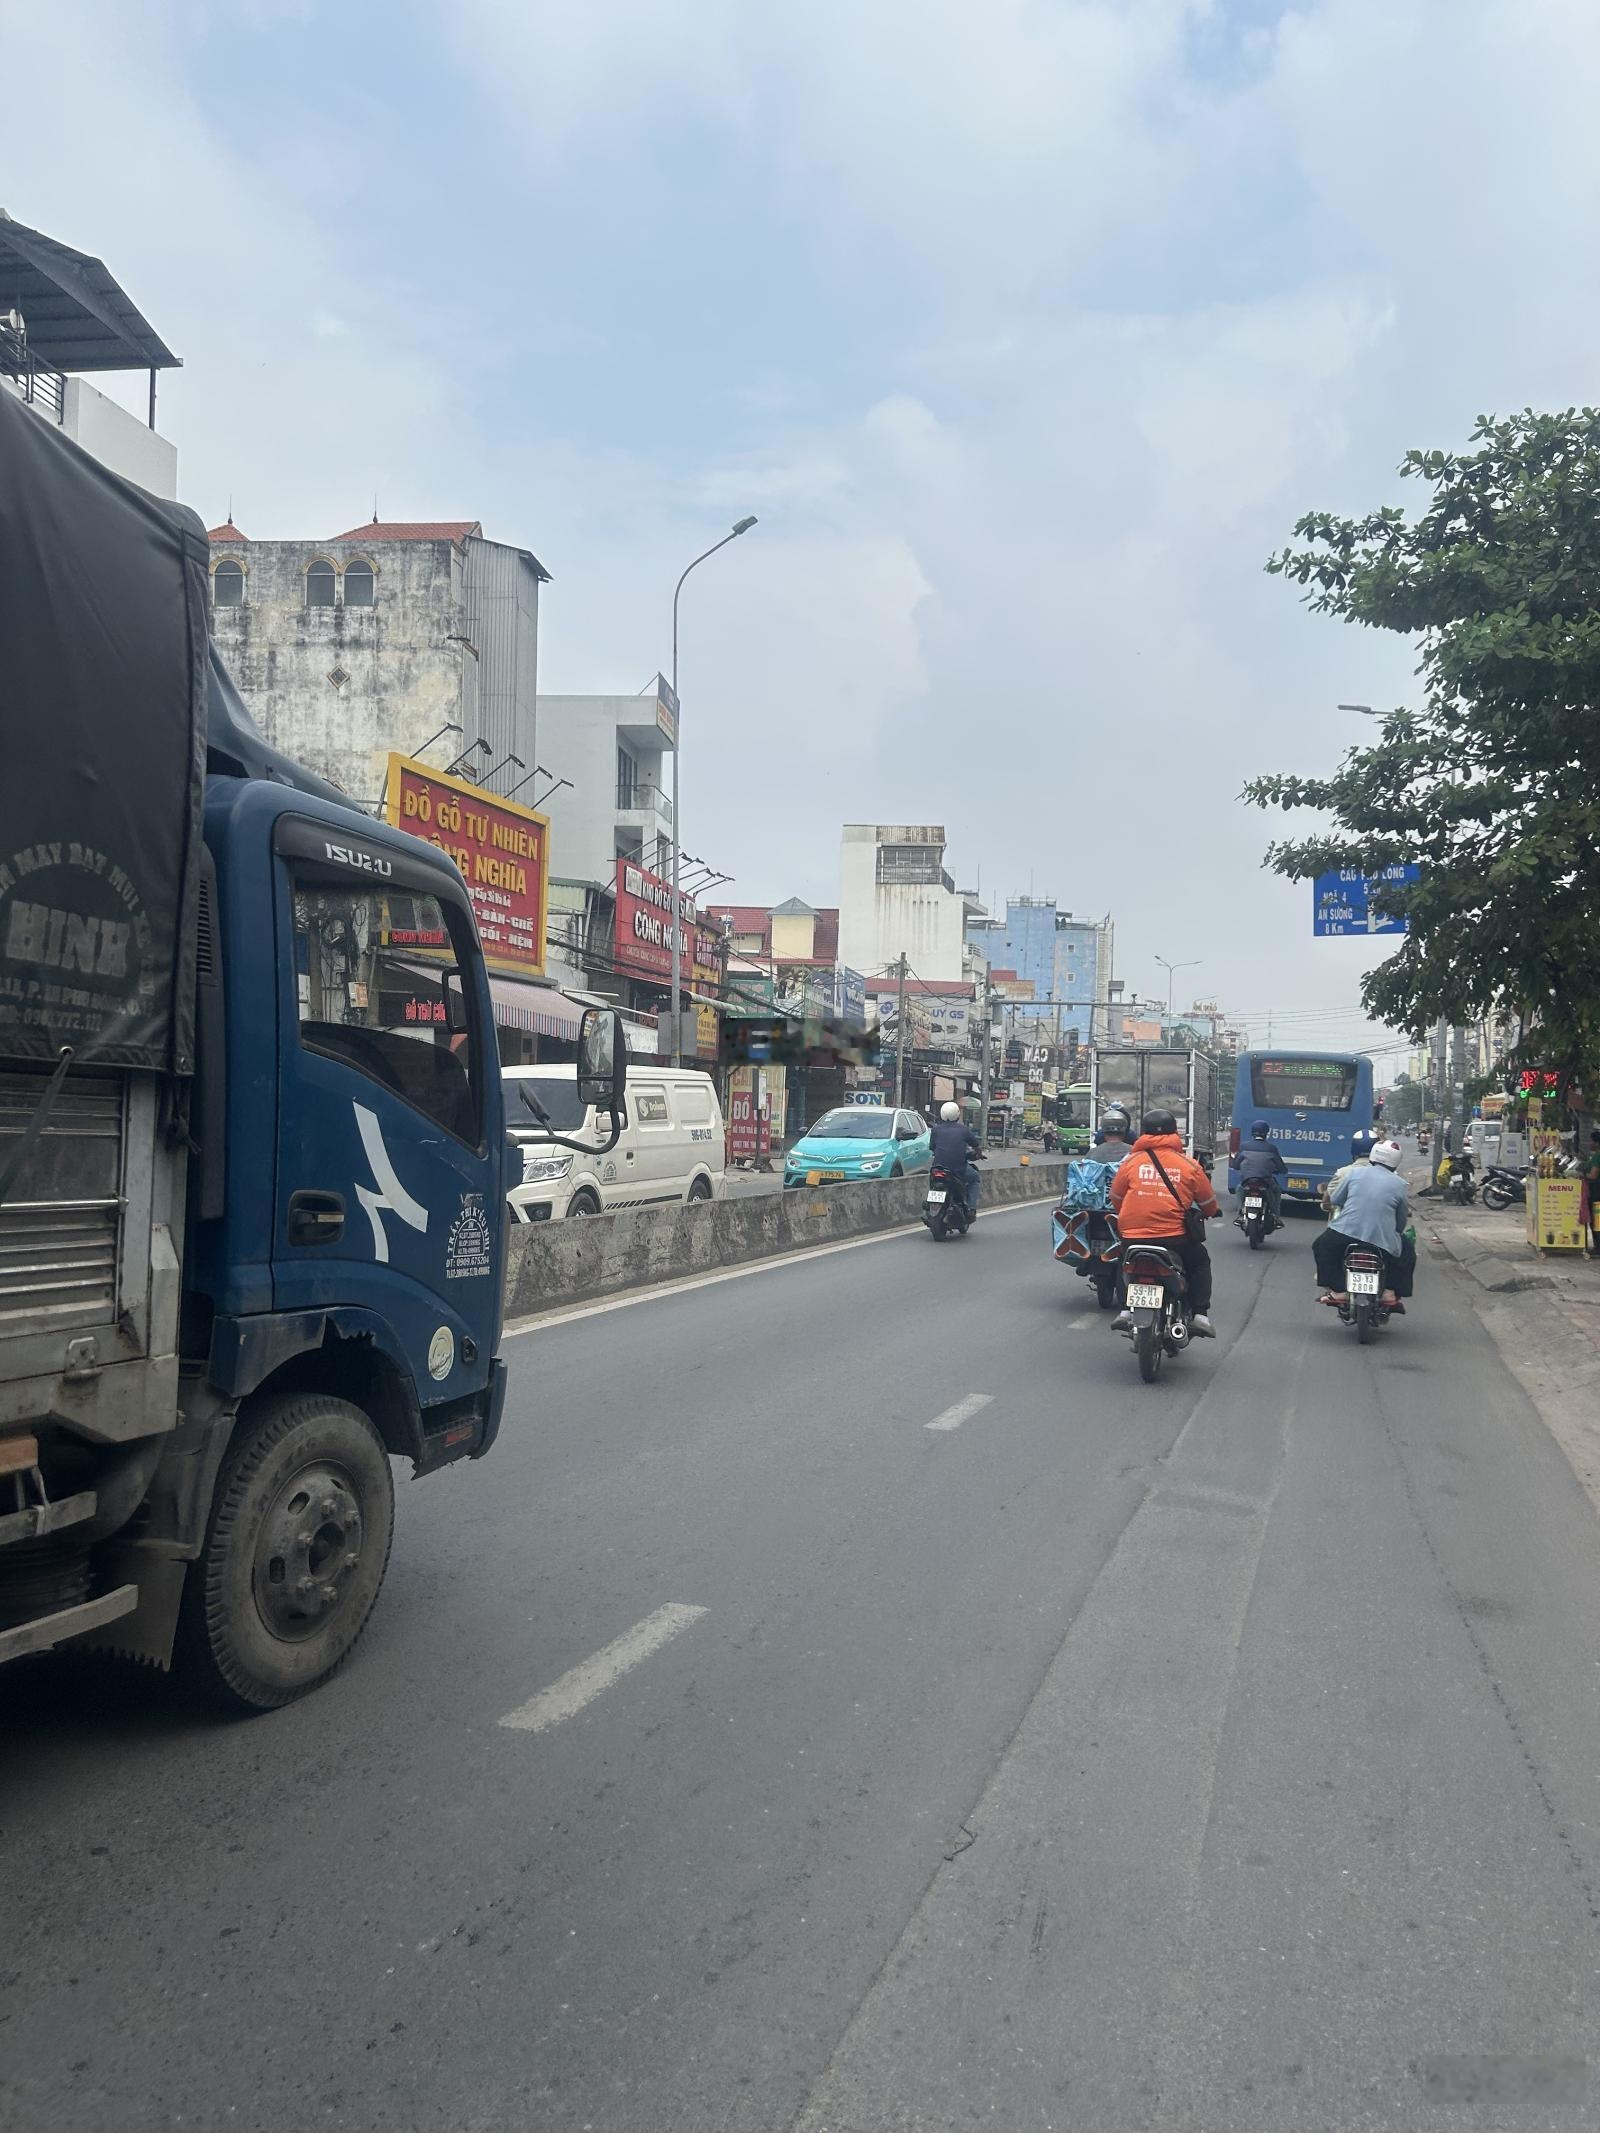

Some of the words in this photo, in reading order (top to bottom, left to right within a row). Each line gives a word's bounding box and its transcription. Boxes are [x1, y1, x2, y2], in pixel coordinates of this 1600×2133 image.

[405, 785, 432, 822] ĐỒ
[436, 795, 462, 833] GỖ
[465, 812, 489, 847] TỰ
[492, 823, 538, 861] NHIÊN
[325, 843, 392, 877] ISUZU
[474, 854, 527, 895] NGHĨA
[1318, 909, 1328, 921] AN
[634, 907, 662, 946] CÔNG
[662, 924, 688, 957] NĨA
[1331, 922, 1344, 934] Km
[929, 1009, 946, 1018] UY
[845, 1092, 882, 1105] SƠN
[1272, 1128, 1331, 1142] 51B-240.25
[1155, 1172, 1181, 1182] Fod
[1129, 1296, 1160, 1307] 526.48
